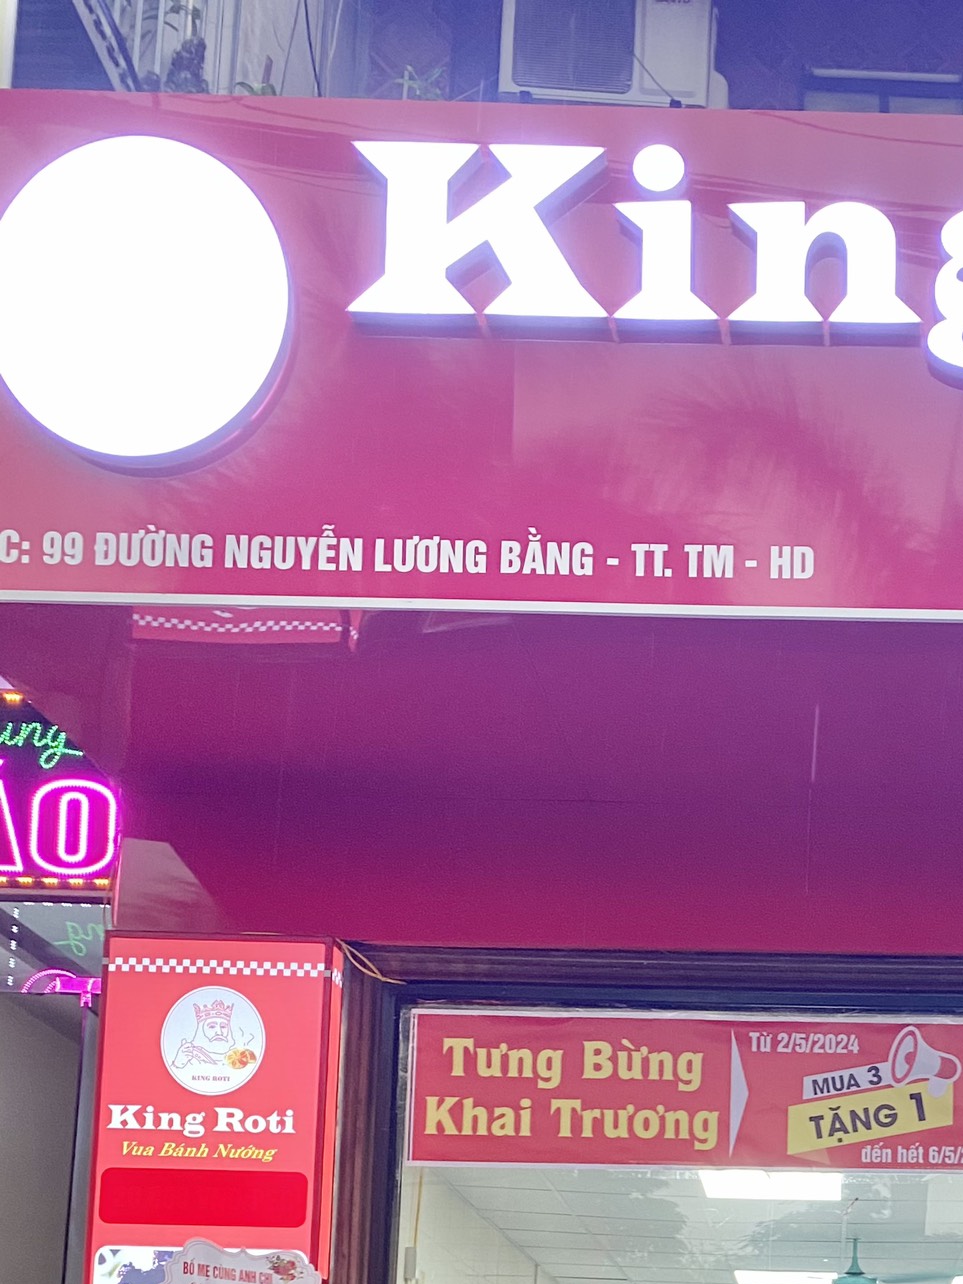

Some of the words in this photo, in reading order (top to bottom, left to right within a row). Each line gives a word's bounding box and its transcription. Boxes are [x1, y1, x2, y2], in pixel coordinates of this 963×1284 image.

[42, 531, 84, 566] 99
[94, 524, 214, 569] ĐƯỜNG
[224, 524, 364, 572] NGUYỄN
[374, 534, 487, 574] LƯƠNG
[500, 526, 594, 576] BẰNG
[631, 543, 673, 578] TT.
[684, 545, 735, 579] TM
[769, 545, 815, 580] HD
[749, 1031, 773, 1053] Từ
[777, 1032, 860, 1055] 2/5/2024
[443, 1037, 564, 1089] Tưng
[582, 1038, 704, 1092] Bừng
[811, 1075, 861, 1096] MUA
[867, 1065, 883, 1087] 3
[106, 1103, 206, 1138] King
[212, 1106, 296, 1135] Roti
[423, 1095, 533, 1137] Khai
[550, 1098, 720, 1151] Trương
[808, 1103, 899, 1144] TẶNG
[909, 1092, 927, 1122] 1
[121, 1140, 155, 1157] Vua
[158, 1141, 210, 1158] Bánh
[213, 1143, 278, 1163] Nướng
[861, 1142, 892, 1164] đến
[897, 1142, 924, 1164] hết
[183, 1257, 195, 1275] BỐ
[197, 1263, 210, 1282] MẸ
[213, 1262, 237, 1281] CÙNG
[238, 1269, 257, 1284] ANH
